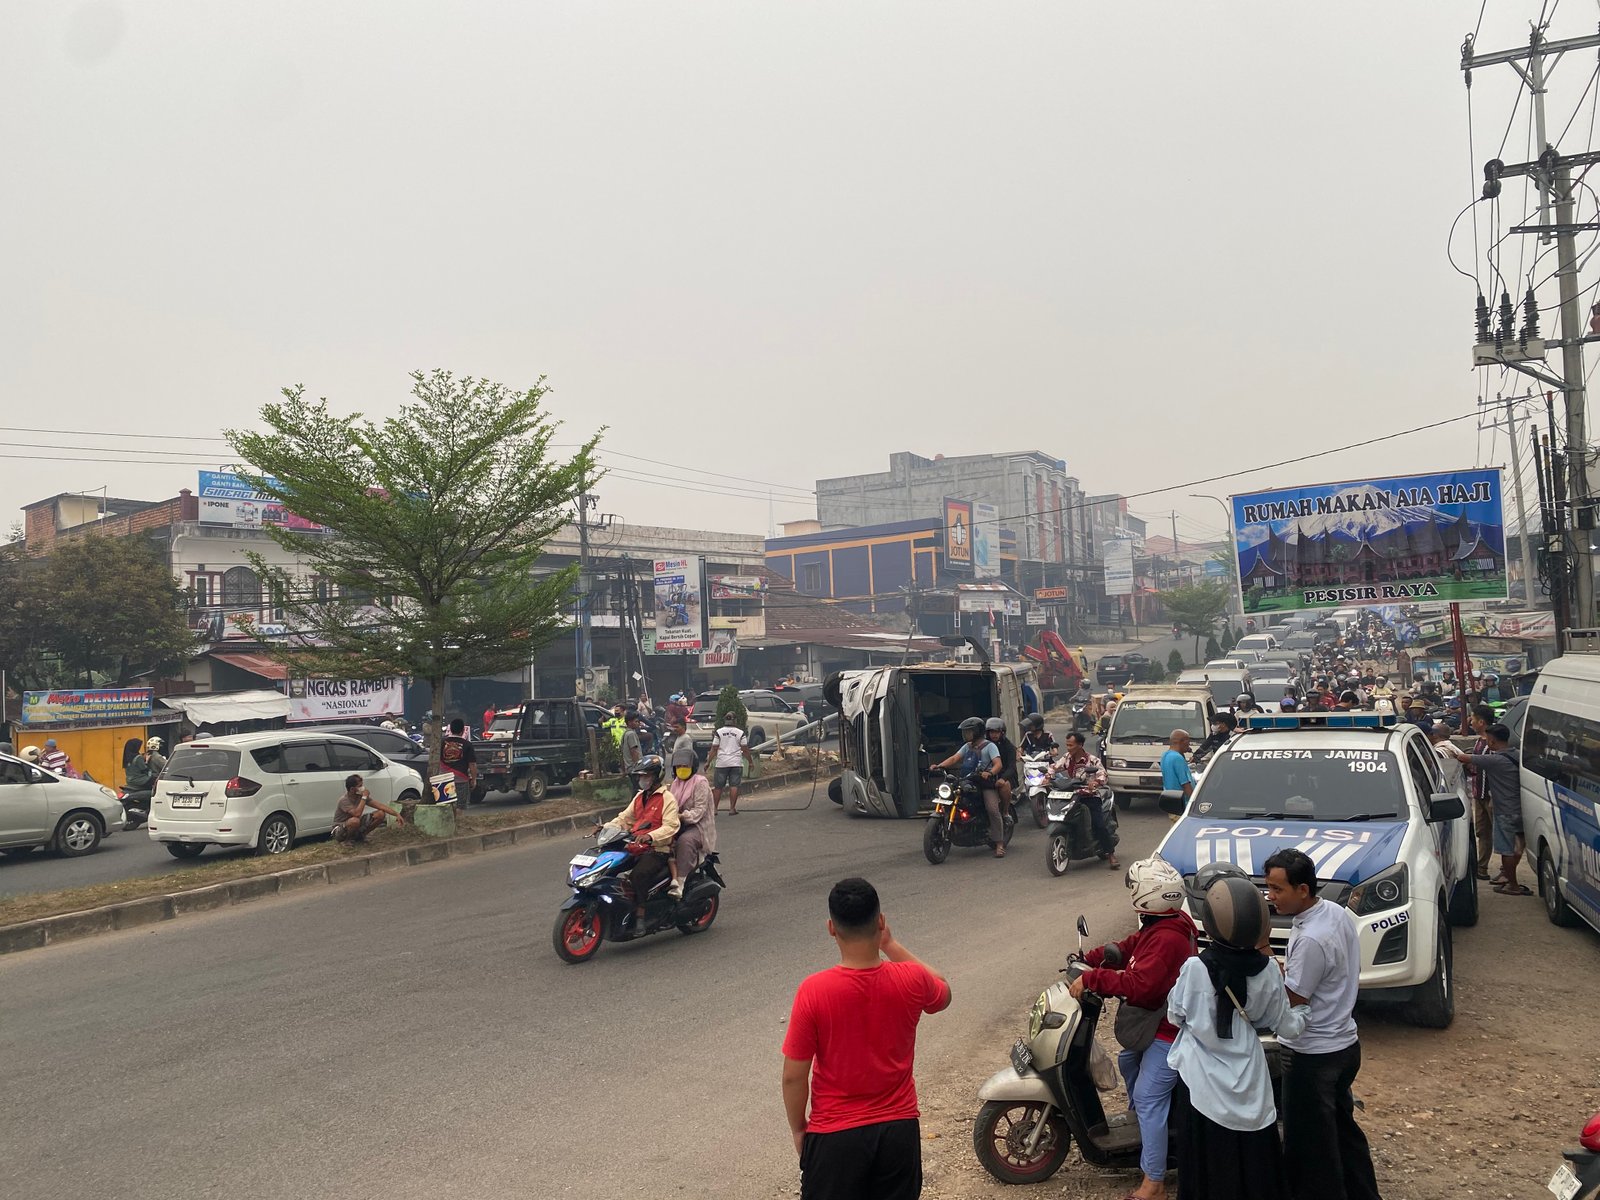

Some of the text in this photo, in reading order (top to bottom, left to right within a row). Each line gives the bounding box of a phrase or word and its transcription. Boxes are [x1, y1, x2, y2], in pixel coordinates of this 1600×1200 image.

[211, 473, 231, 481] GANTI
[205, 487, 252, 499] SINERGI
[208, 501, 230, 509] IPONE
[1244, 482, 1491, 524] RUMAH MAKAN AIA HAJI
[950, 547, 969, 558] JOTUN
[1044, 590, 1065, 598] JOTUN
[1304, 582, 1438, 605] PESISIR RAYA
[307, 676, 396, 697] NGKAS RAMBUT
[84, 690, 150, 703] REKLAME
[1231, 750, 1378, 761] POLRESTA JAMBI
[1347, 761, 1388, 773] 1904
[1195, 827, 1372, 843] POLISI
[1370, 910, 1410, 933] POLISI
